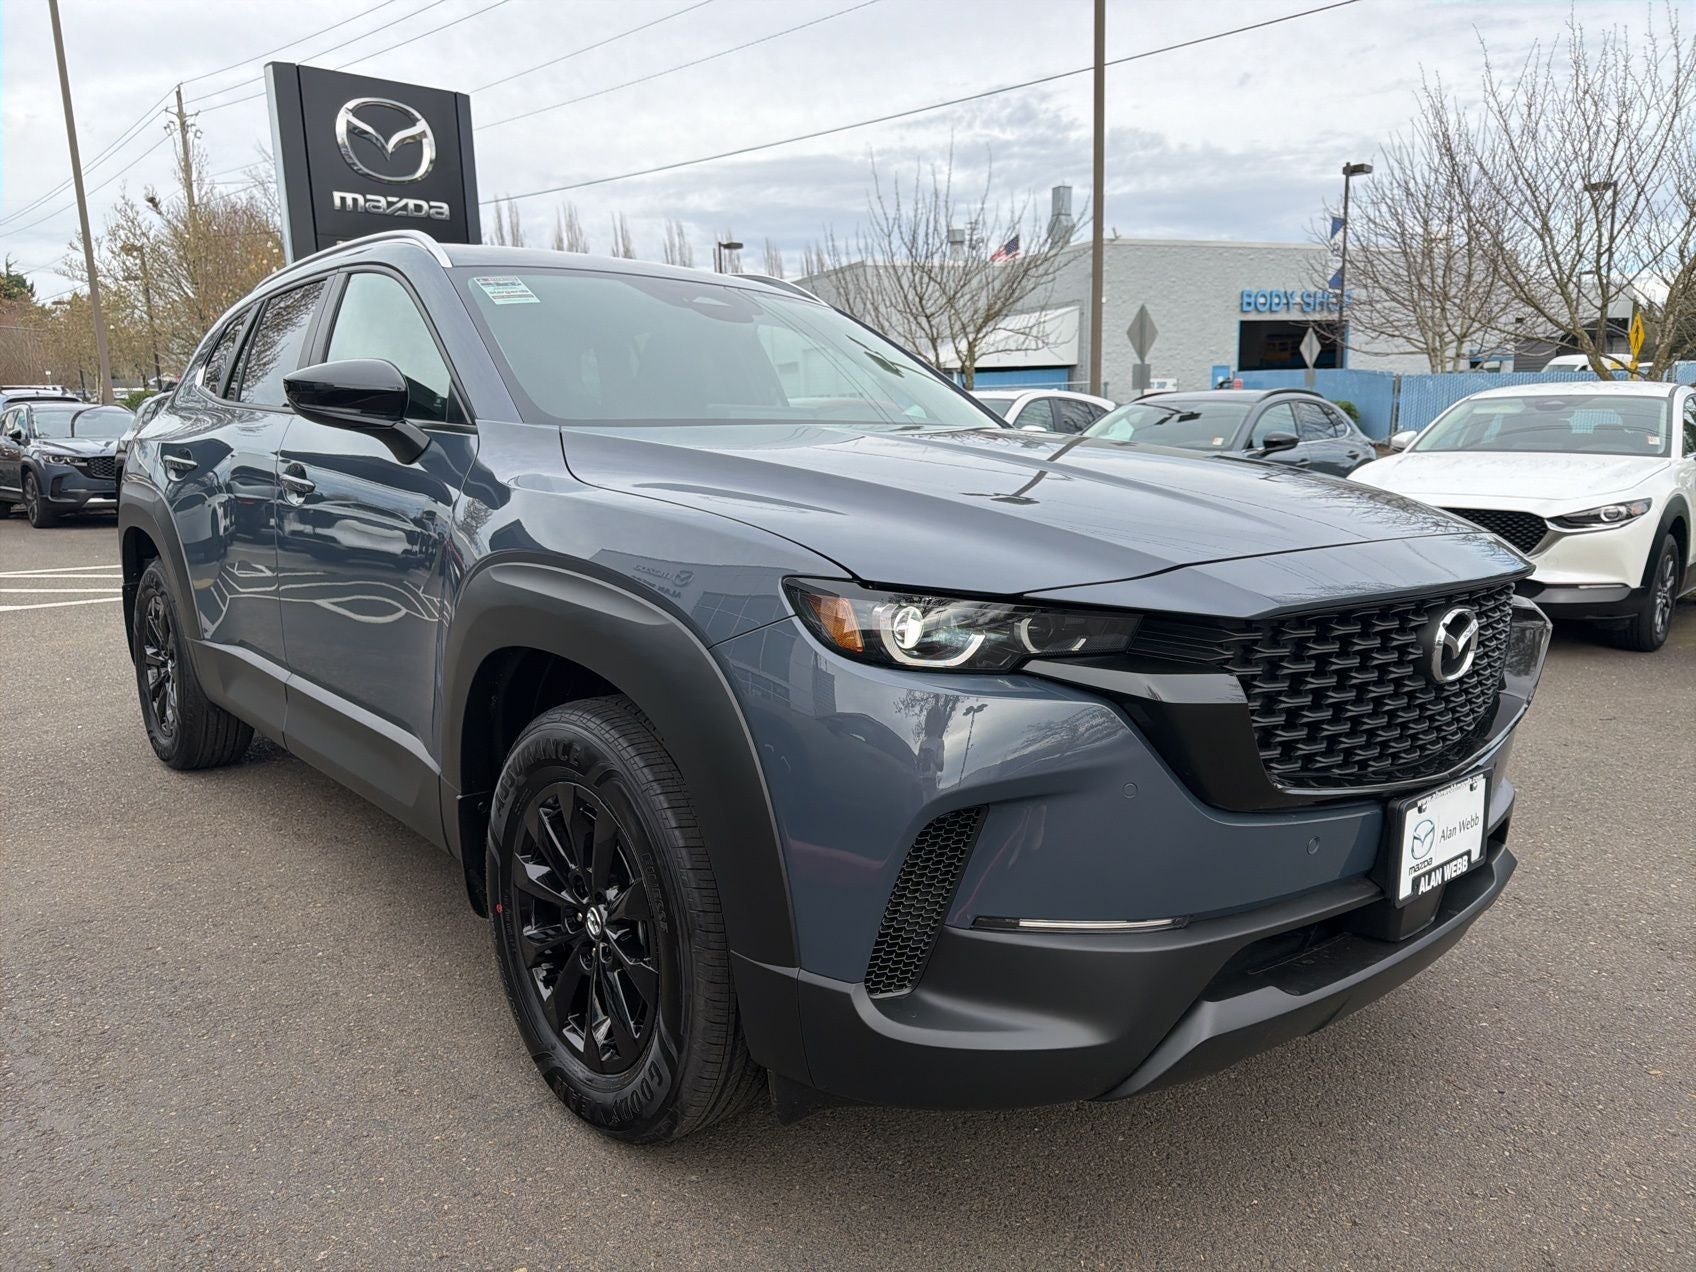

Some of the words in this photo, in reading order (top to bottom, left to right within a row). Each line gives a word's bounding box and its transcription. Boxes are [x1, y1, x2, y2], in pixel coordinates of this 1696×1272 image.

[332, 191, 451, 221] mazda
[1240, 289, 1296, 313] BODY
[1439, 825, 1457, 844] Alan
[1458, 813, 1480, 835] Webb
[1418, 868, 1443, 895] ALAN
[1444, 855, 1469, 882] WEBB
